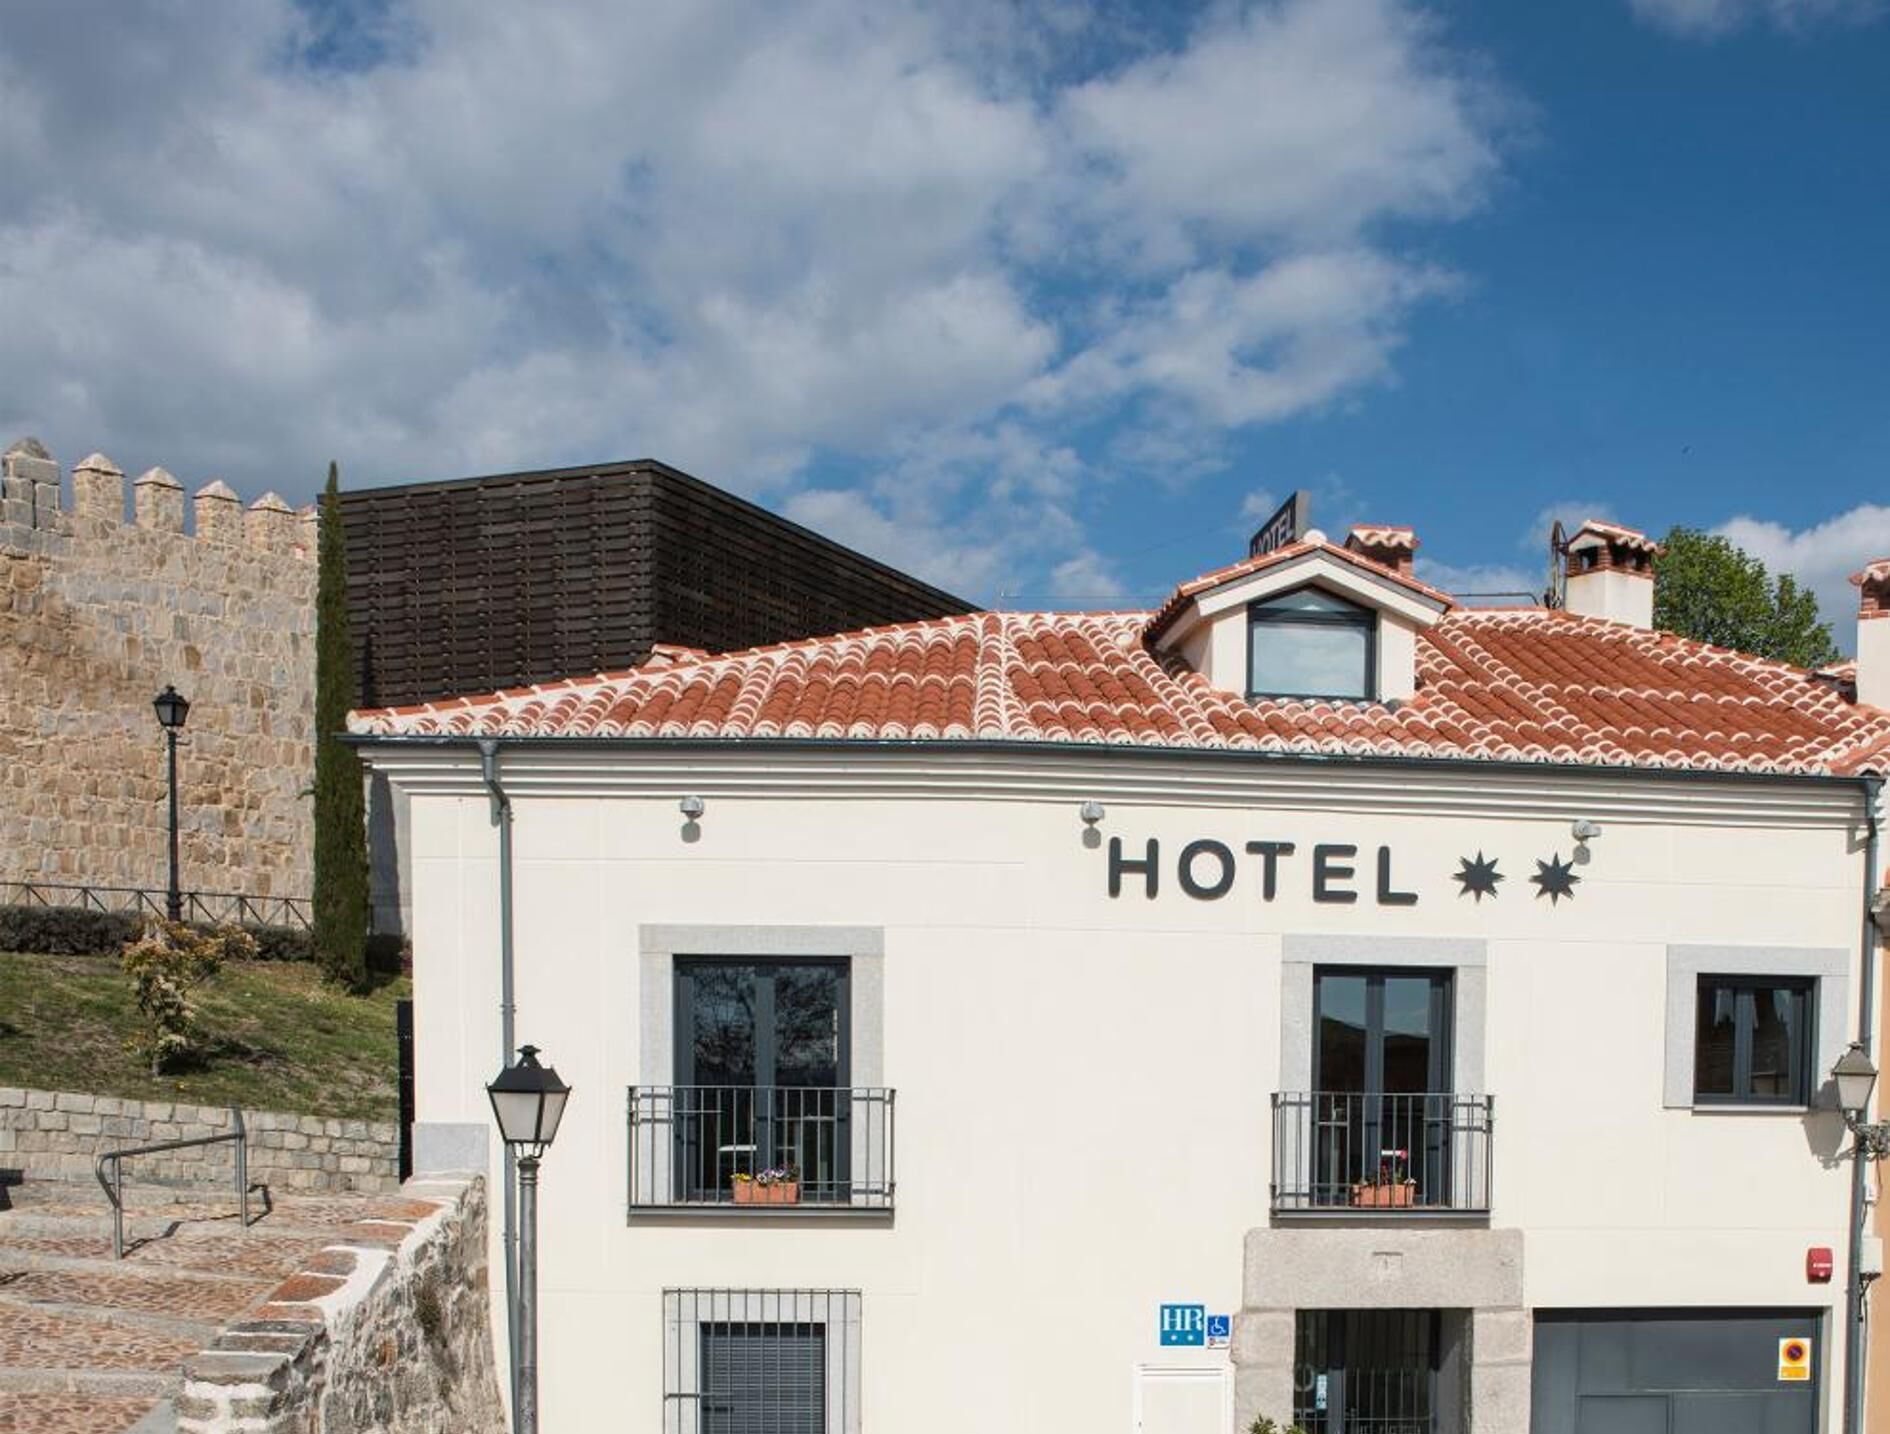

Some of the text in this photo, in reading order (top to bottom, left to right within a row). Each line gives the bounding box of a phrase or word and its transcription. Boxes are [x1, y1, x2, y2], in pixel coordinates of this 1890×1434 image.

[1252, 506, 1294, 555] HOTEL
[1108, 836, 1419, 906] HOTEL
[1162, 1308, 1203, 1331] HR
